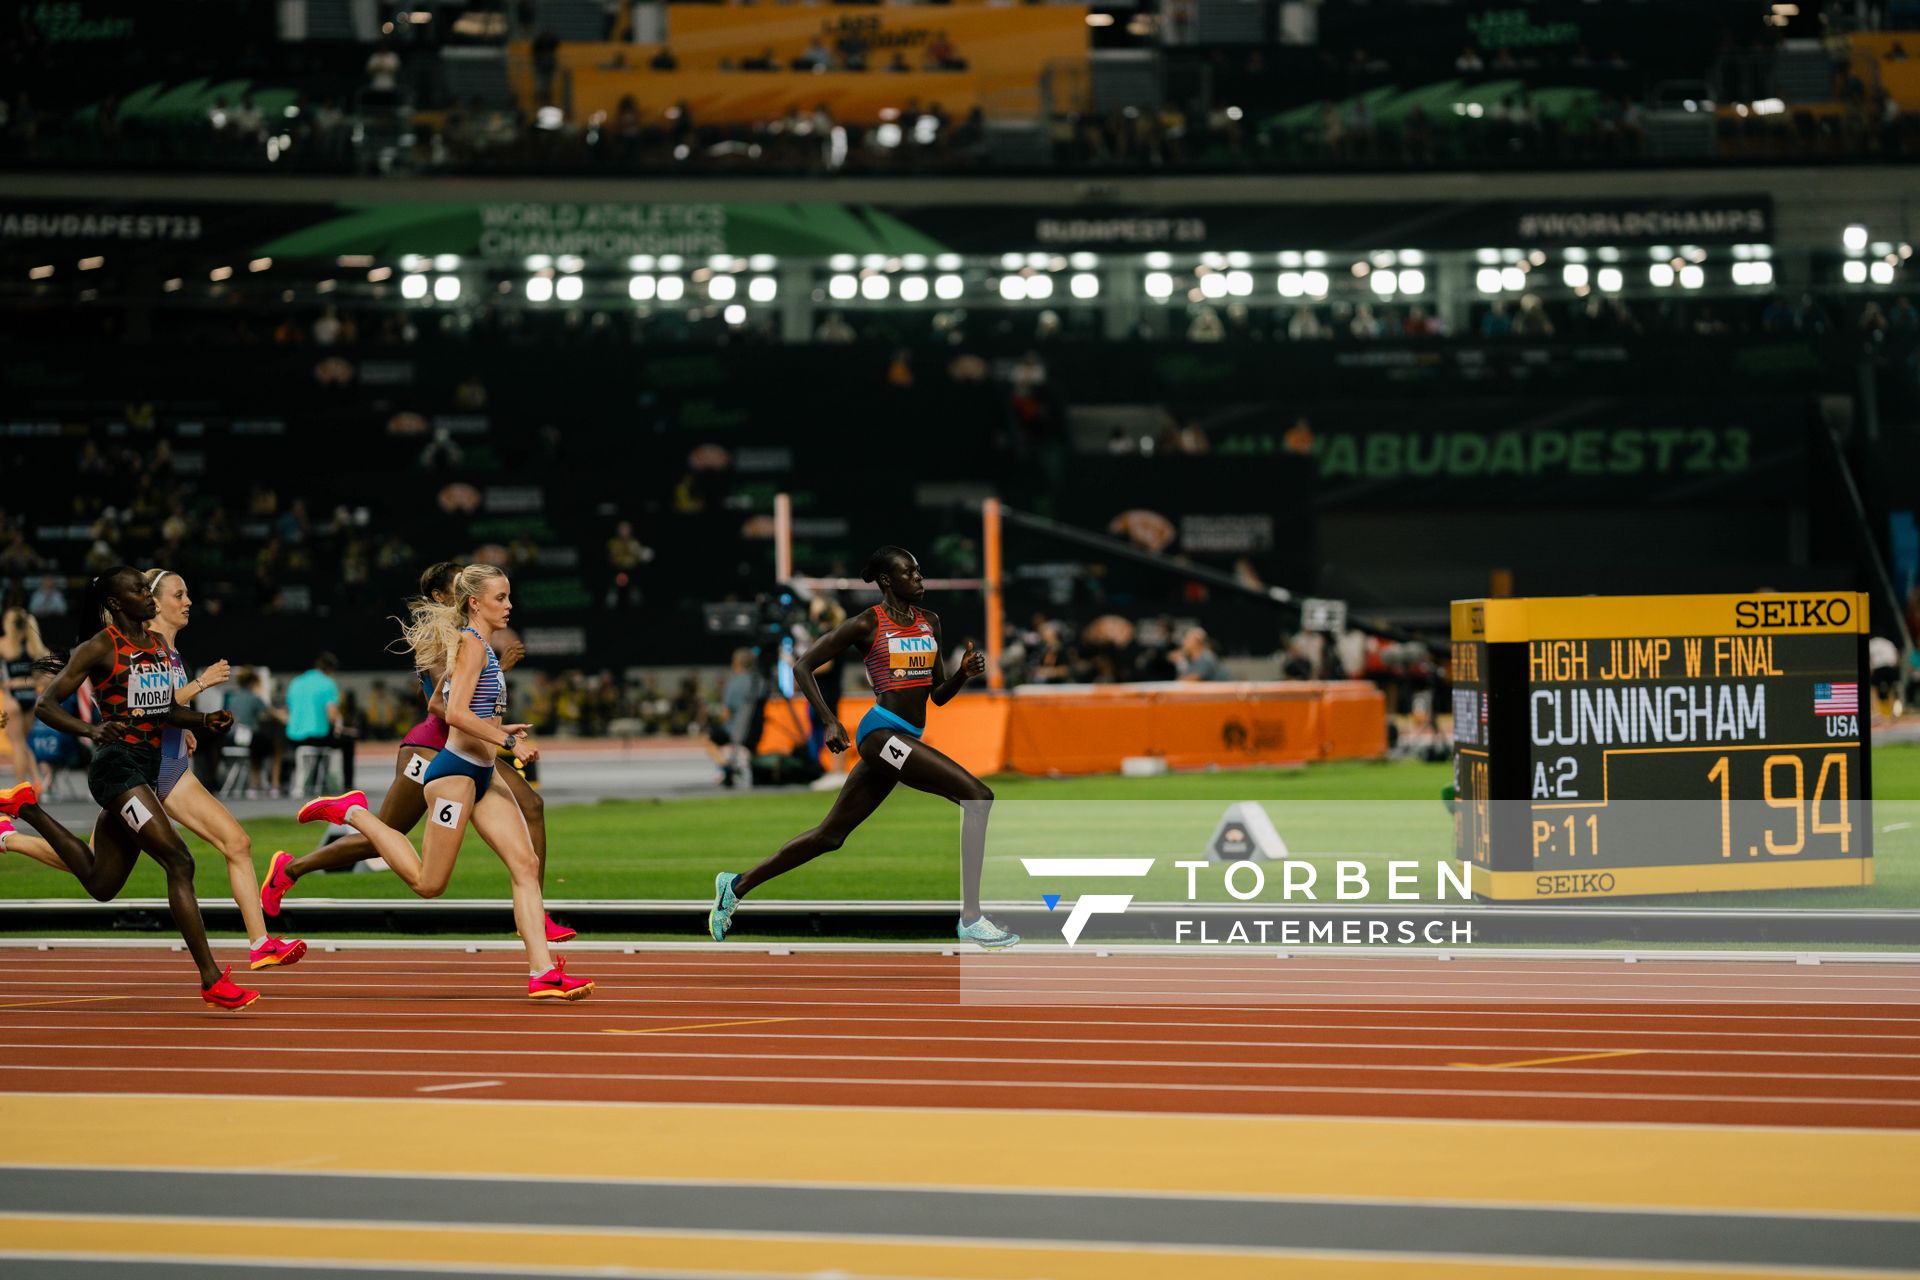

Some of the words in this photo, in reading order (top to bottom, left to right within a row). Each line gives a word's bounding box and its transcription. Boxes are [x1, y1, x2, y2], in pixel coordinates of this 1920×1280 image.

[0, 213, 201, 238] ABUDAPEST23
[1736, 598, 1850, 628] SEIKO
[900, 637, 932, 651] NTN
[909, 656, 925, 668] MU
[1529, 640, 1588, 682] HIGH
[1600, 638, 1671, 680] JUMP
[1684, 638, 1702, 678] W
[1714, 636, 1784, 677] FINAL
[140, 673, 170, 689] NTN
[1530, 684, 1766, 746] CUNNINGHAM
[1826, 715, 1859, 737] USA
[889, 744, 905, 760] 4
[411, 760, 422, 777] 3
[1532, 756, 1579, 799] A:2
[125, 804, 140, 825] 7
[1707, 752, 1852, 858] 1.94
[1532, 814, 1598, 858] P:11
[1536, 873, 1616, 895] SEIKO
